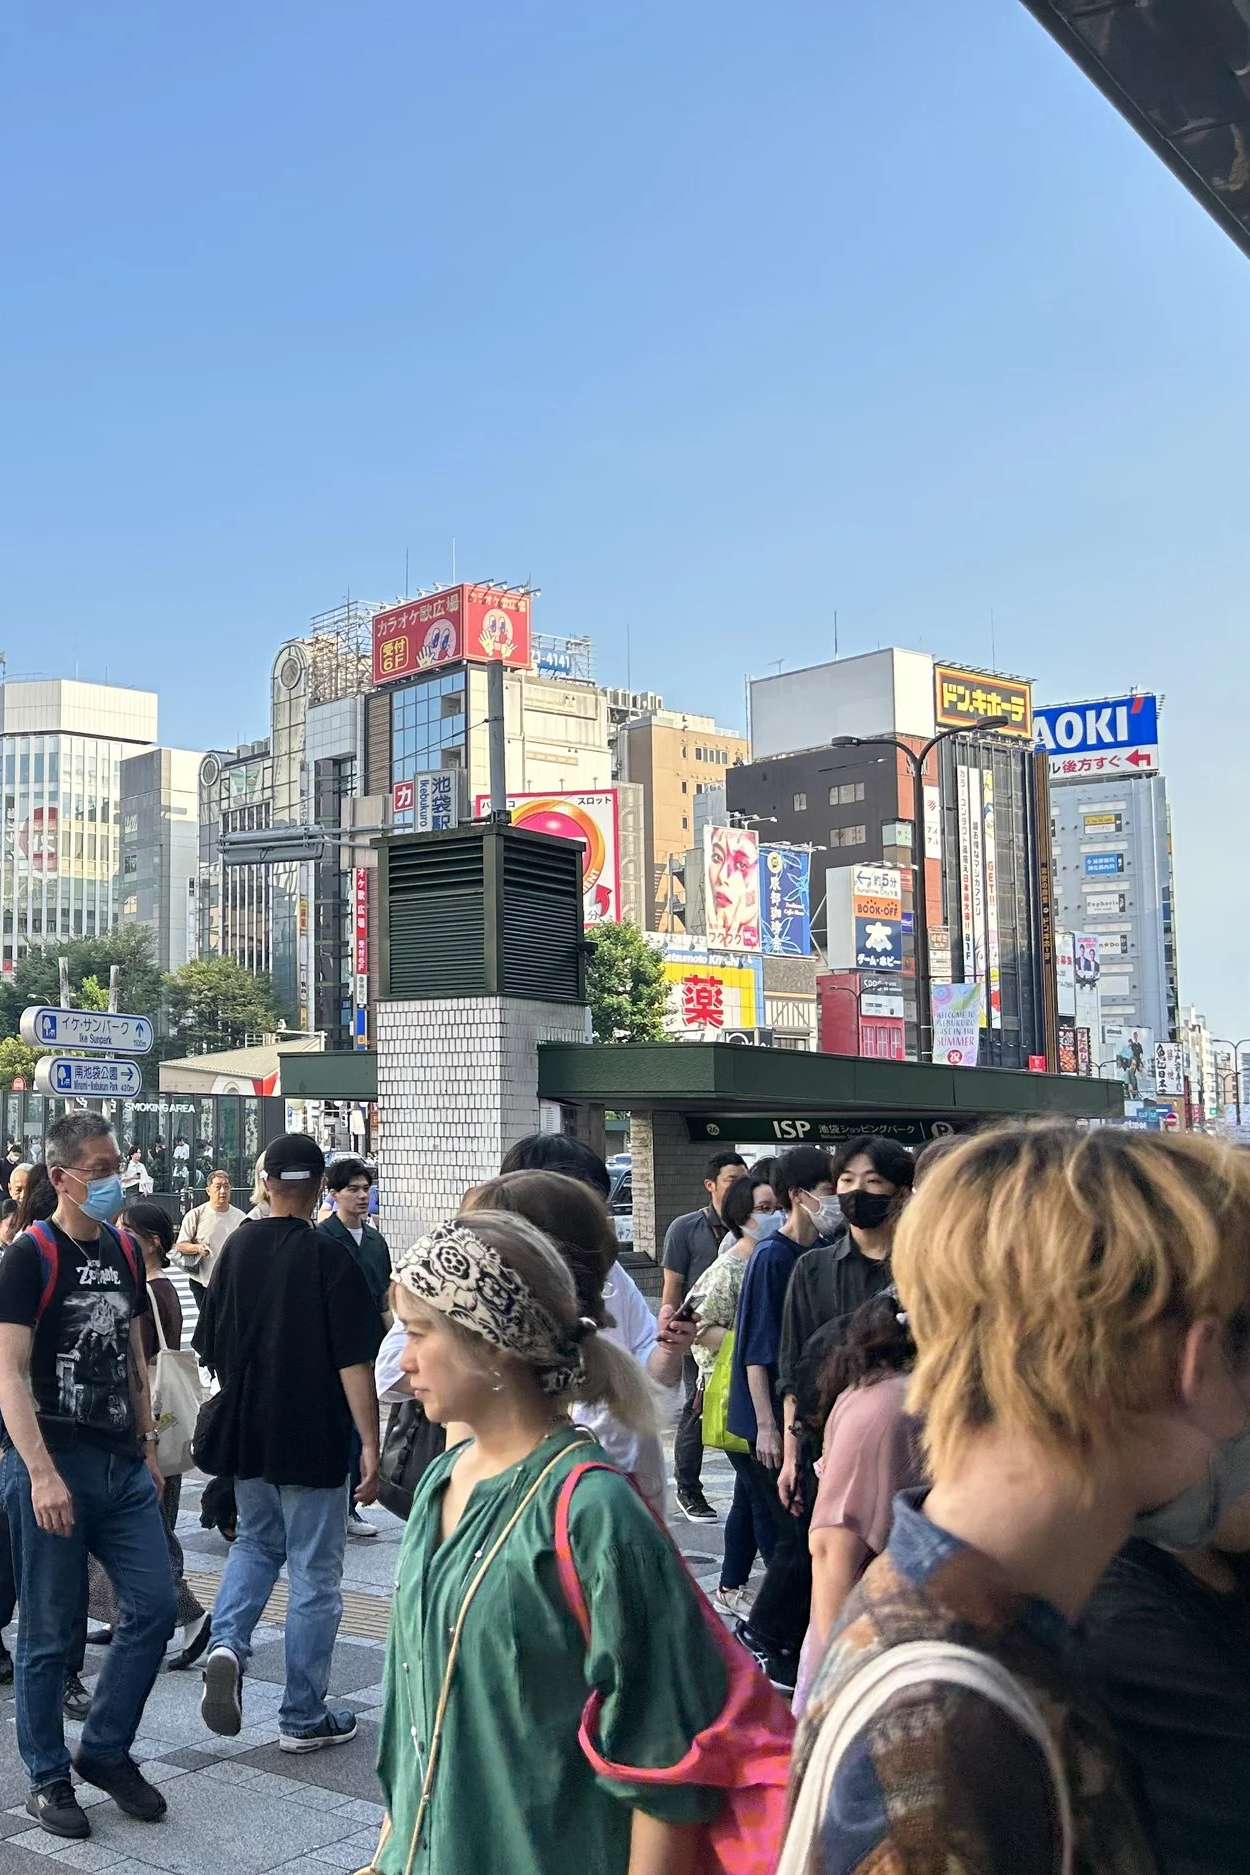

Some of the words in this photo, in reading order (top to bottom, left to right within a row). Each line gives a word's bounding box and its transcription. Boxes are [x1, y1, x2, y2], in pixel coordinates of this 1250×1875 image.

[377, 593, 459, 638] カラオケ歌広場
[382, 638, 406, 656] 受付
[383, 656, 405, 671] 6F
[1033, 705, 1129, 750] AOKI
[397, 786, 412, 807] カ
[419, 779, 430, 828] Ikebukuro
[431, 775, 452, 831] 池袋駅
[578, 796, 612, 805] スロット
[873, 873, 897, 888] 約5分
[986, 860, 995, 907] GET!!
[709, 932, 741, 945] ワクワク
[857, 953, 902, 968] ゲーム・ホビー
[682, 974, 724, 1028] 薬
[61, 1016, 129, 1035] イケ・サンパーク
[79, 1032, 88, 1043] Ike
[89, 1034, 112, 1045] Sunpark
[936, 1036, 975, 1047] SUMMER
[74, 1065, 118, 1080] 南池袋公園
[120, 1084, 135, 1092] 420m
[124, 1102, 168, 1114] SMOKING
[168, 1103, 196, 1114] AREA
[772, 1120, 811, 1139] ISP
[818, 1123, 916, 1135] 池袋ショッピングパーク
